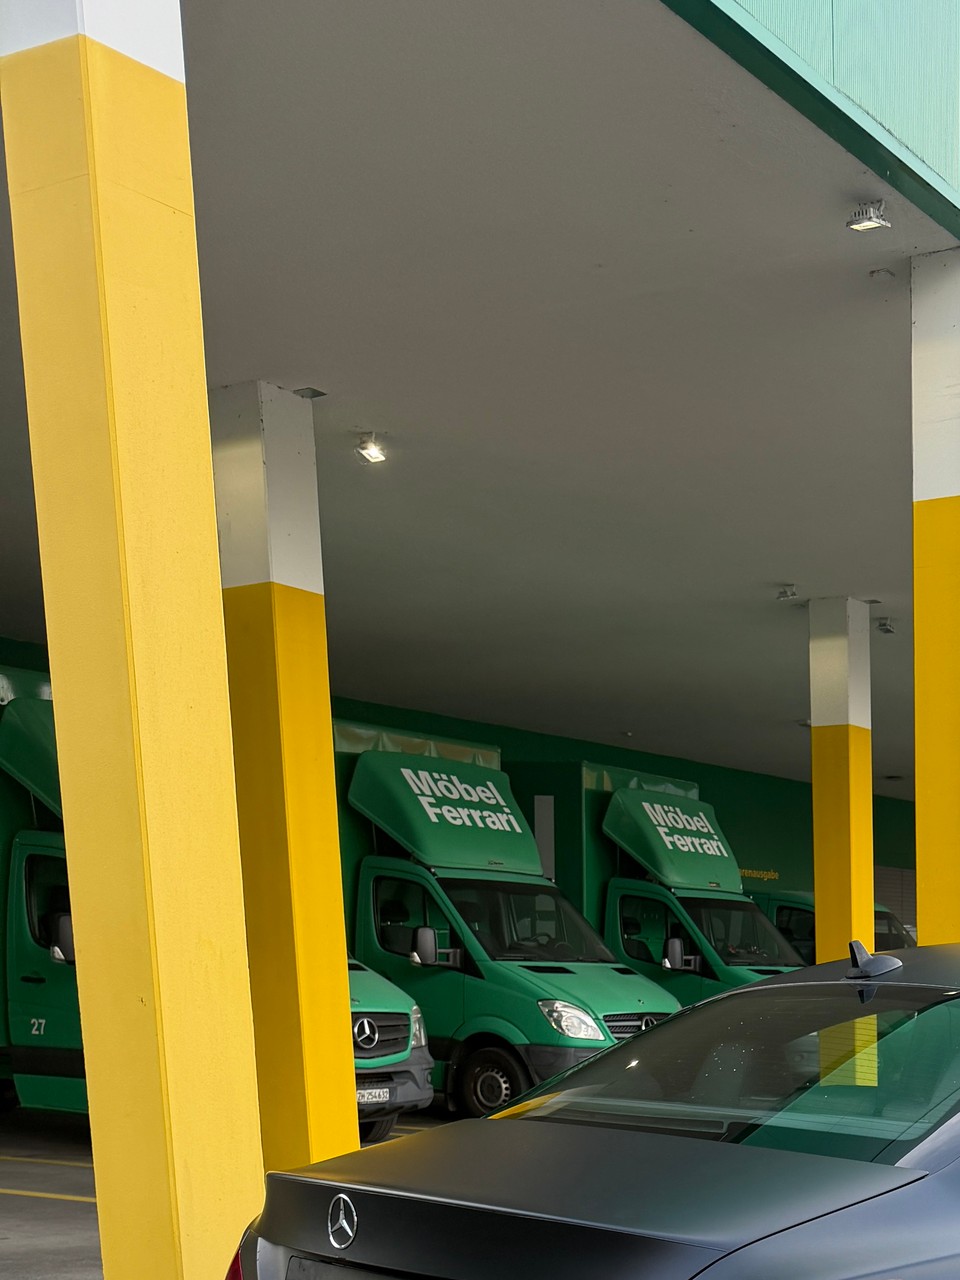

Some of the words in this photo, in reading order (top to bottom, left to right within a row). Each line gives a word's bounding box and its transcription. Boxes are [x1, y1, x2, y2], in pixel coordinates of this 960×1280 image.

[400, 767, 507, 806] Möbel
[417, 795, 523, 833] Ferrari
[641, 801, 715, 834] Möbel
[656, 826, 729, 857] Ferrari
[30, 1018, 46, 1035] 27
